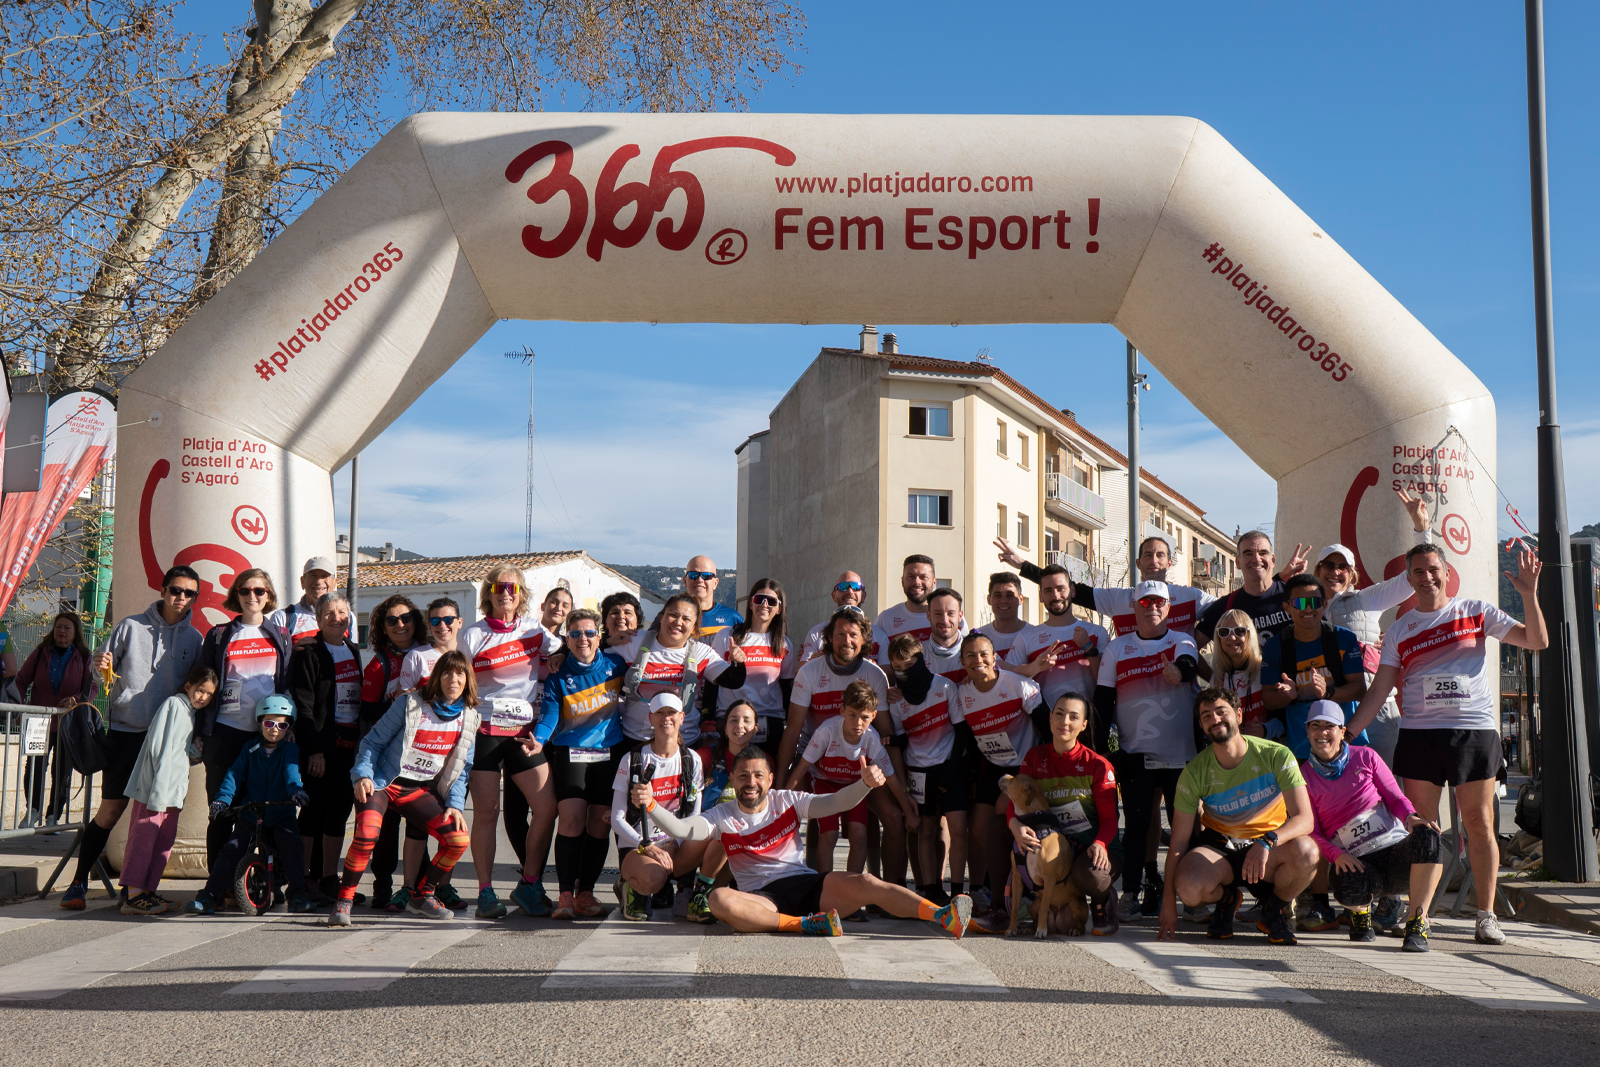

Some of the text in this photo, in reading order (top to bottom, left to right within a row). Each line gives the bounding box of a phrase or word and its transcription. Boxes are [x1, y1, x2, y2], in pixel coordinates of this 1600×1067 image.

[774, 172, 1034, 198] www.platjadaro.com
[504, 136, 796, 262] 365
[774, 207, 884, 251] Fem
[254, 241, 404, 382] #platjadaro365
[1201, 241, 1354, 382] #platjadaro365
[182, 437, 267, 454] Platja d'Aro
[1393, 445, 1435, 461] Platja
[181, 454, 274, 472] Castell d'Aro
[1392, 462, 1442, 477] Castell
[181, 471, 240, 487] S'Agaró
[1392, 479, 1448, 496] S'Agaró
[1, 546, 33, 588] Fem
[1253, 610, 1292, 630] ABADELL
[1428, 636, 1447, 646] PLATJA
[222, 689, 233, 697] 48
[1435, 681, 1458, 691] 258
[505, 704, 522, 713] 216
[570, 688, 618, 716] PALAMÓS
[985, 741, 1001, 749] 314
[414, 757, 433, 768] 218
[1218, 801, 1239, 813] FELIU
[1239, 796, 1250, 808] DE
[1057, 811, 1072, 821] 72
[1350, 820, 1371, 838] 237
